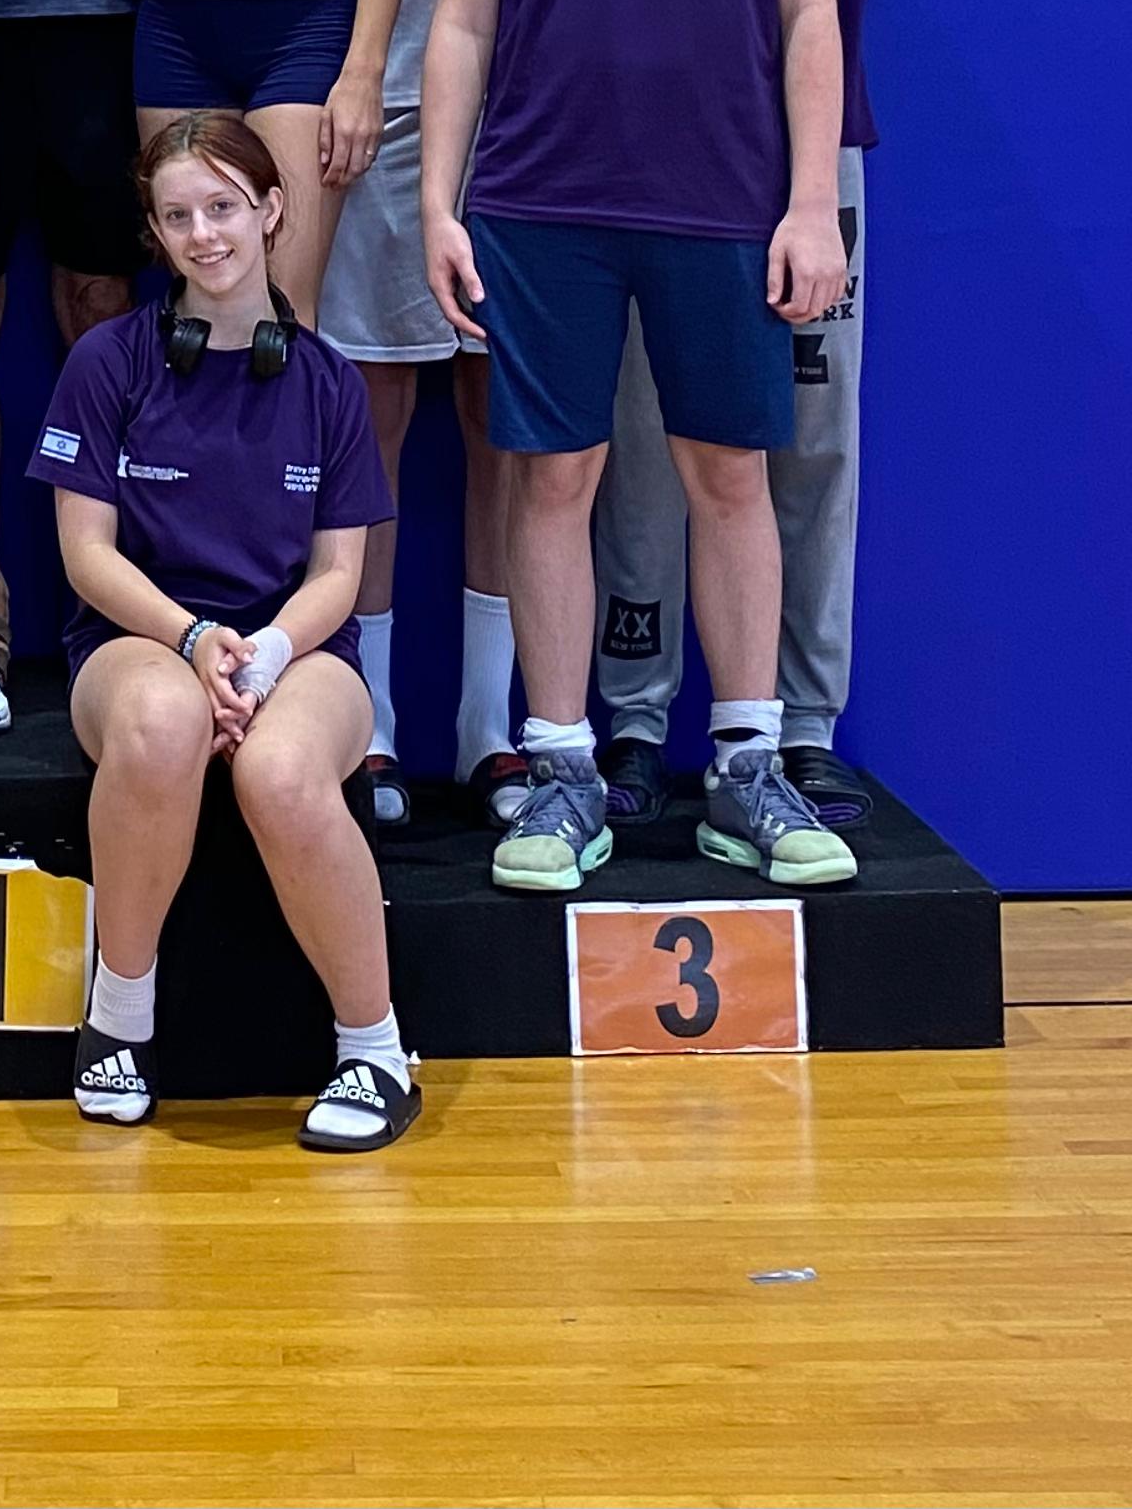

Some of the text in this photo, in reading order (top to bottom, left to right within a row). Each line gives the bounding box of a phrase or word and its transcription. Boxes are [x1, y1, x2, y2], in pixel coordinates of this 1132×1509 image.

[614, 607, 653, 639] XX
[653, 916, 720, 1038] 3
[81, 1071, 147, 1092] adidas
[318, 1084, 386, 1109] adidas
